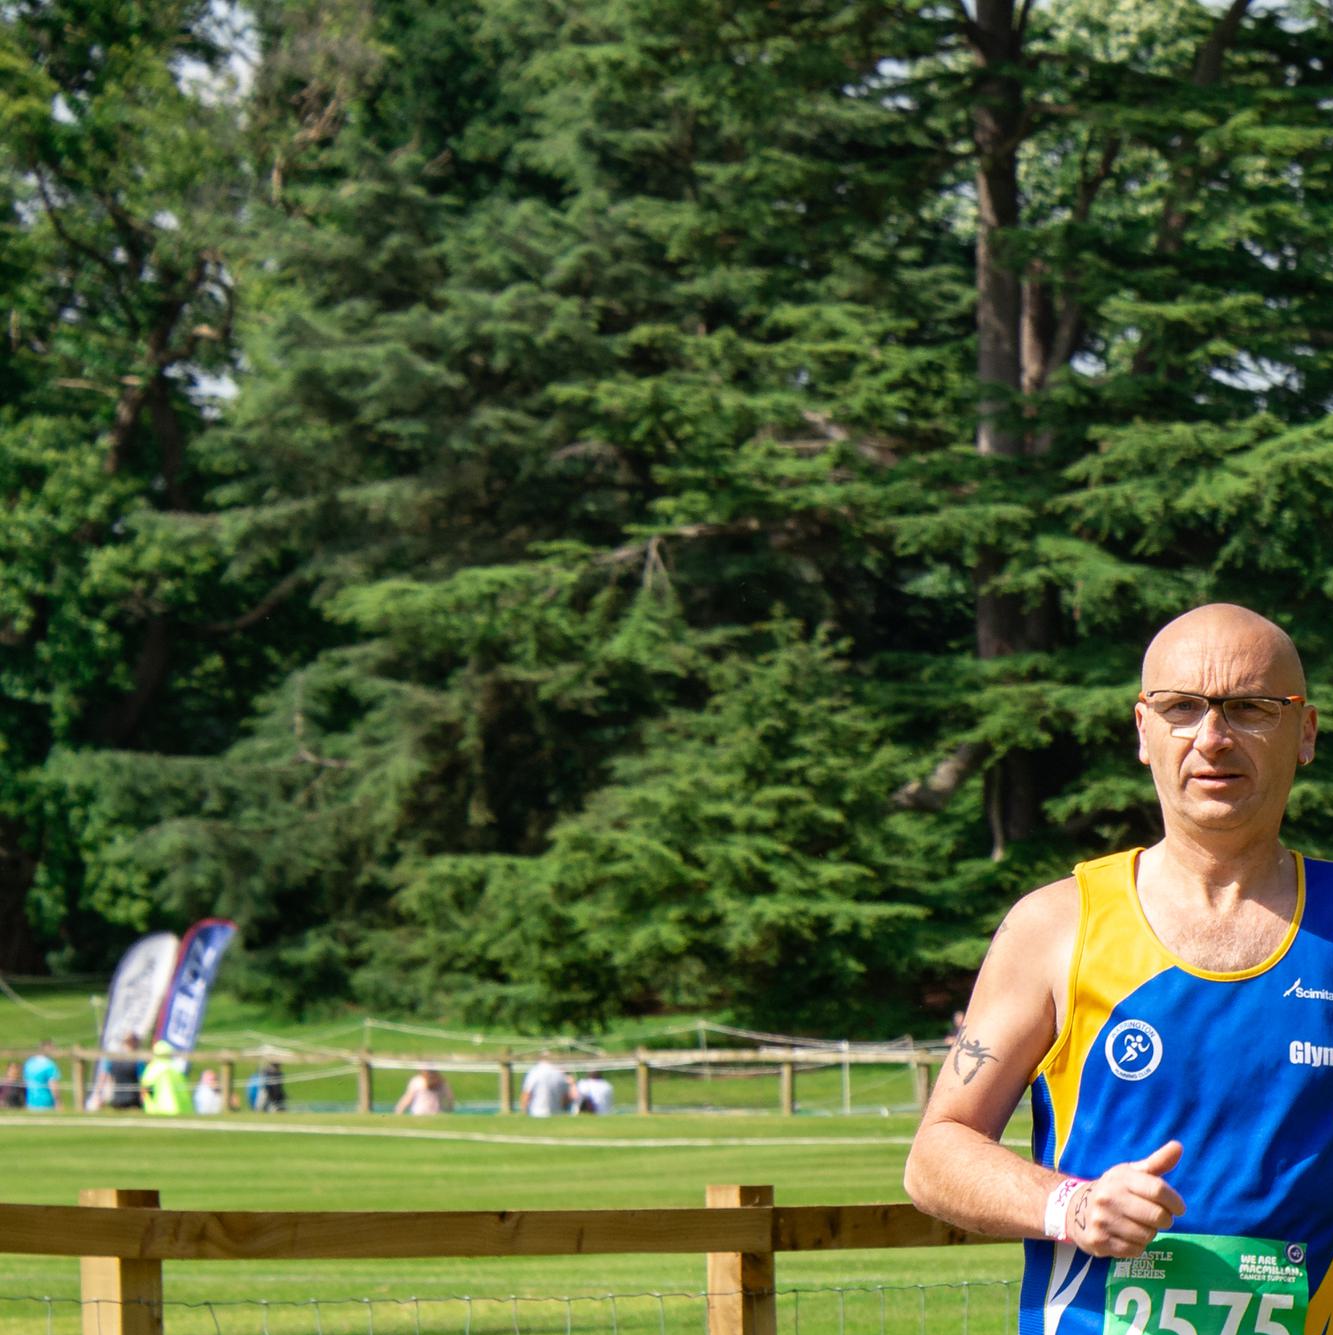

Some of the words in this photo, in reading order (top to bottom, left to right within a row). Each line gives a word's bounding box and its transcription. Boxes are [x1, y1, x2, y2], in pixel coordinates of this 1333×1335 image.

[1137, 1251, 1174, 1261] ASTLE
[1241, 1255, 1256, 1264] WE
[1258, 1255, 1277, 1265] ARE
[1132, 1260, 1155, 1270] RUN
[1131, 1270, 1166, 1280] SERIES
